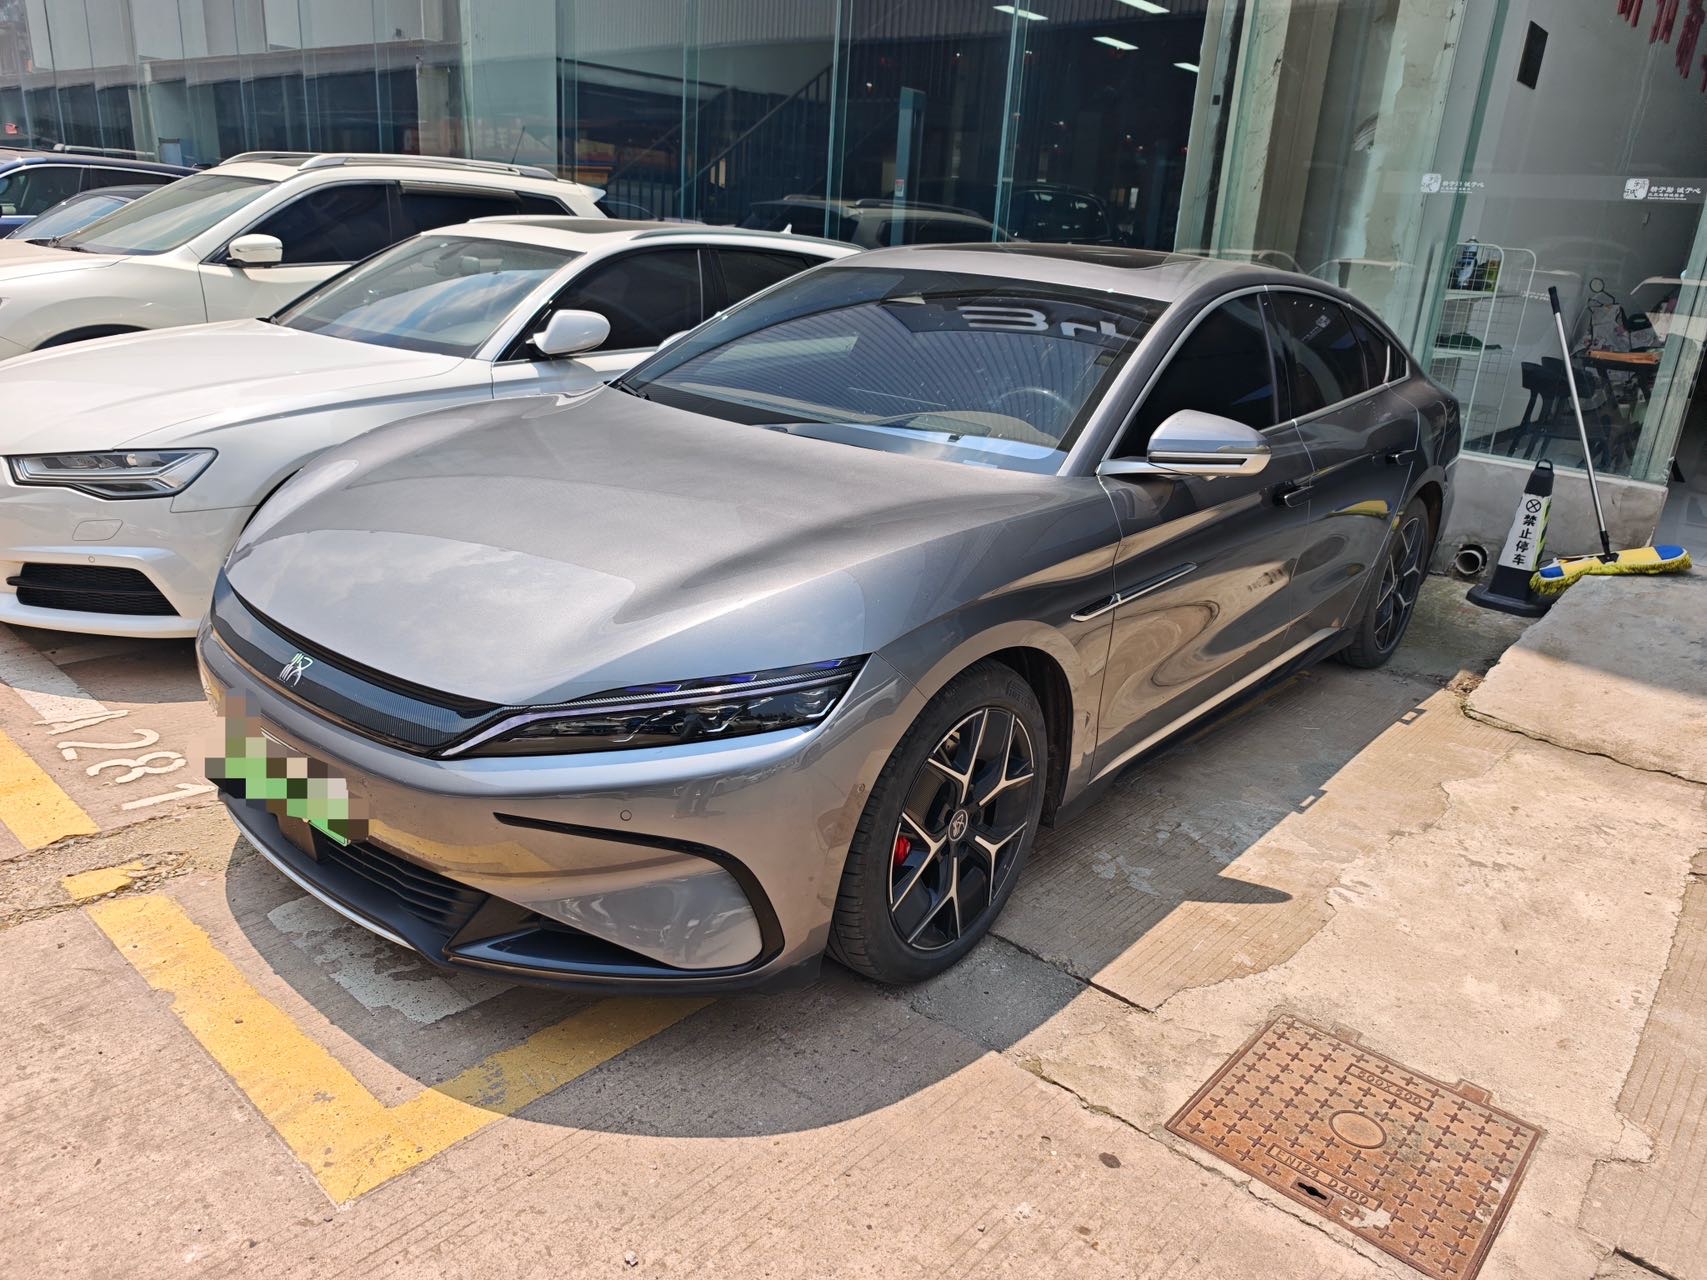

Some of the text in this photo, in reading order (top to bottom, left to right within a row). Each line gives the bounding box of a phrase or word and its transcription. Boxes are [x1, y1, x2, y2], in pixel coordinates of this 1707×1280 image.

[1512, 514, 1537, 566] 禁止停车
[1327, 1178, 1369, 1205] D400
